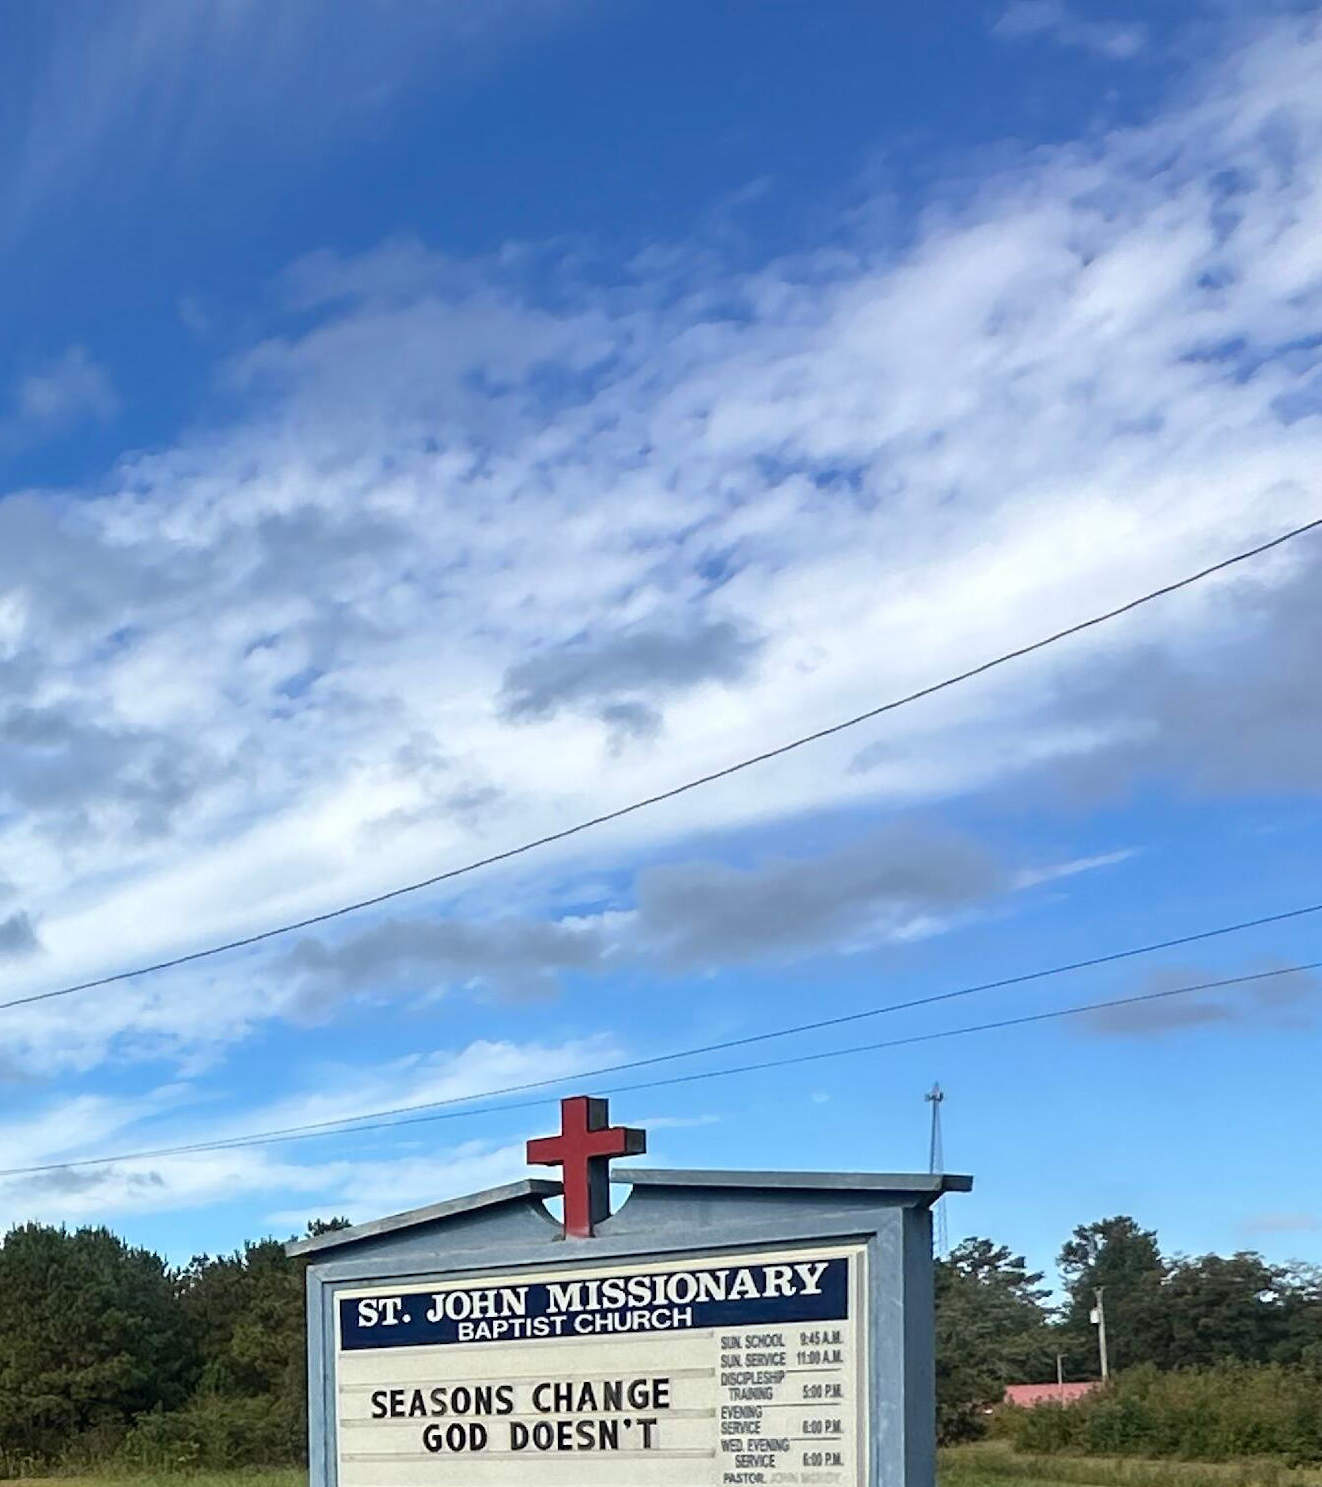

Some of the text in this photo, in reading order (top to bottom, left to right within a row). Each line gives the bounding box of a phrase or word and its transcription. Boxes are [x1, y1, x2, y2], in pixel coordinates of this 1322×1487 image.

[358, 1262, 829, 1327] ST. JOHN MISSIONARY
[457, 1306, 693, 1341] BAPTIST CHURCH
[744, 1333, 786, 1349] SCHOOL
[744, 1351, 787, 1367] SERVICE
[720, 1370, 785, 1386] DISCIPLESHIP
[371, 1378, 670, 1419] SEASONS CHANGE
[728, 1386, 774, 1402] TRAINING
[720, 1404, 763, 1420] EVENING
[422, 1418, 658, 1453] GOD DOESN'T
[720, 1420, 761, 1435] SERVICE
[747, 1437, 791, 1453] EVENING
[734, 1454, 776, 1469] SERVICE
